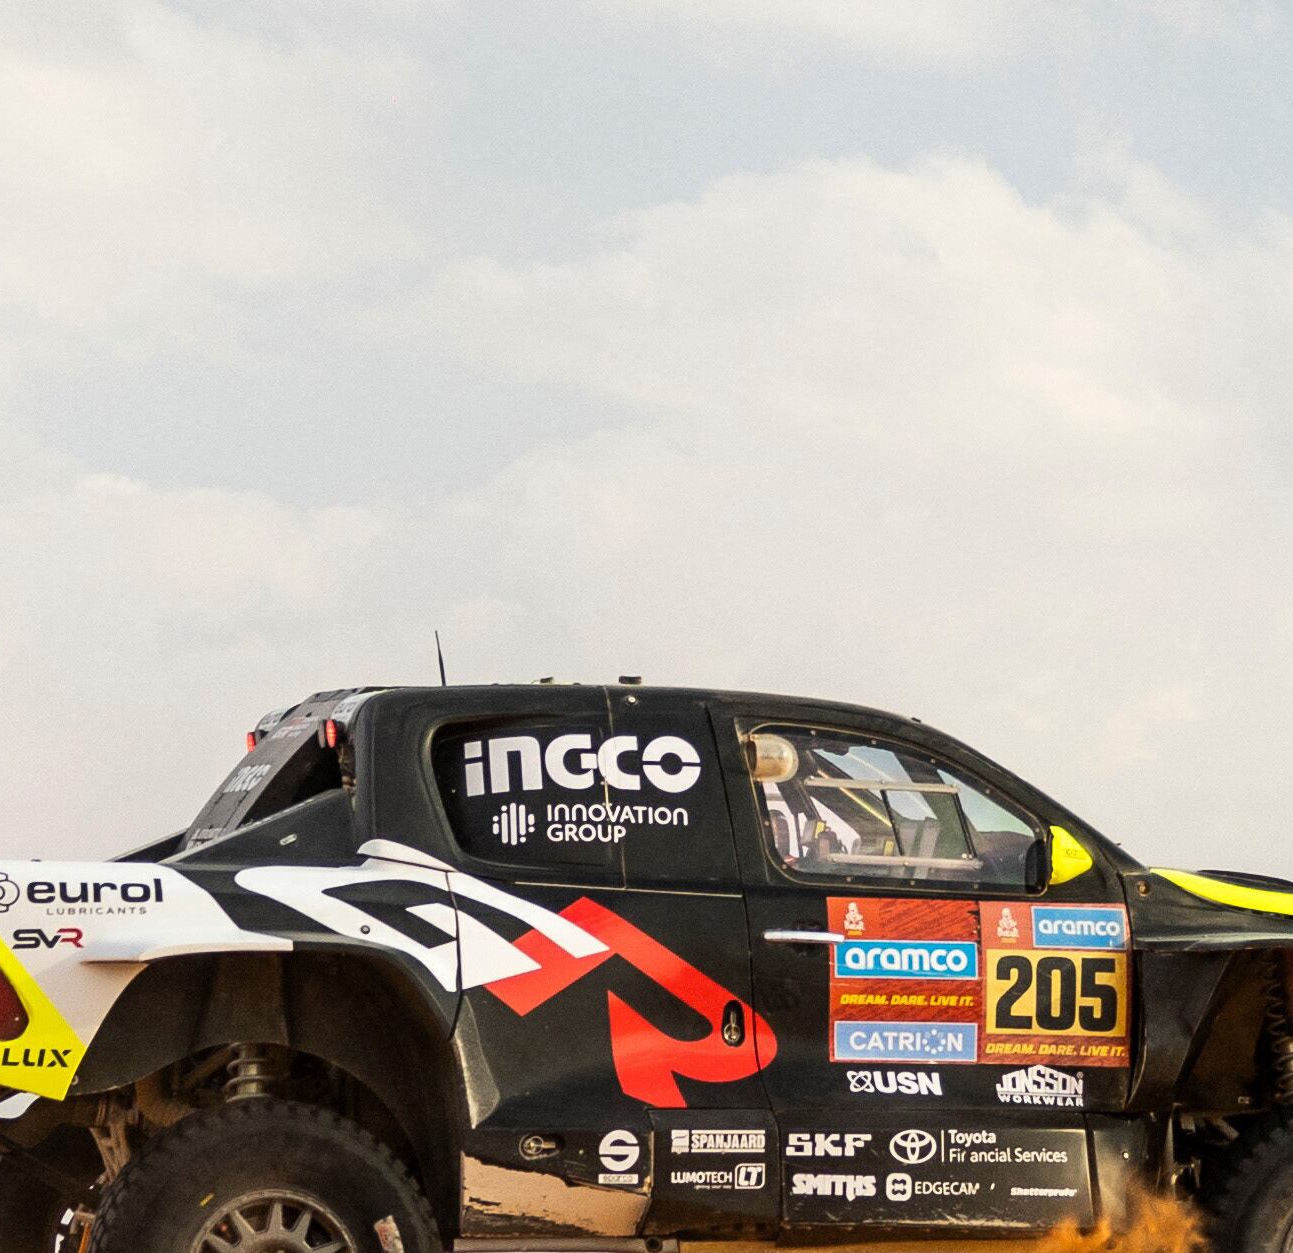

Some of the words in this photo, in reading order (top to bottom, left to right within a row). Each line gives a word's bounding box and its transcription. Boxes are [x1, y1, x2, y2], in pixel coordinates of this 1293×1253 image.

[546, 823, 626, 843] GROUP
[27, 878, 164, 904] eurol
[46, 906, 147, 916] LUBRICANTS
[1038, 919, 1120, 937] aramco
[12, 928, 84, 950] SVR
[844, 947, 968, 972] aramco
[929, 995, 958, 1006] LIVE
[995, 955, 1118, 1032] 205
[849, 1029, 963, 1055] CATRION
[985, 1043, 1037, 1054] DREAM.
[1038, 1044, 1077, 1056] DARE.
[1079, 1045, 1109, 1057] LIVE
[873, 1071, 943, 1096] USN
[995, 1064, 1084, 1095] JONSSON
[997, 1093, 1084, 1107] WORKWEAR
[691, 1134, 766, 1149] SPANJAARD
[786, 1133, 872, 1157] SKF
[948, 1129, 997, 1147] Toyota
[1014, 1147, 1068, 1163] Services
[670, 1171, 733, 1184] LUMOTECH
[738, 1166, 763, 1187] LT
[792, 1173, 877, 1202] SMITHS
[914, 1181, 980, 1195] EDGECAM
